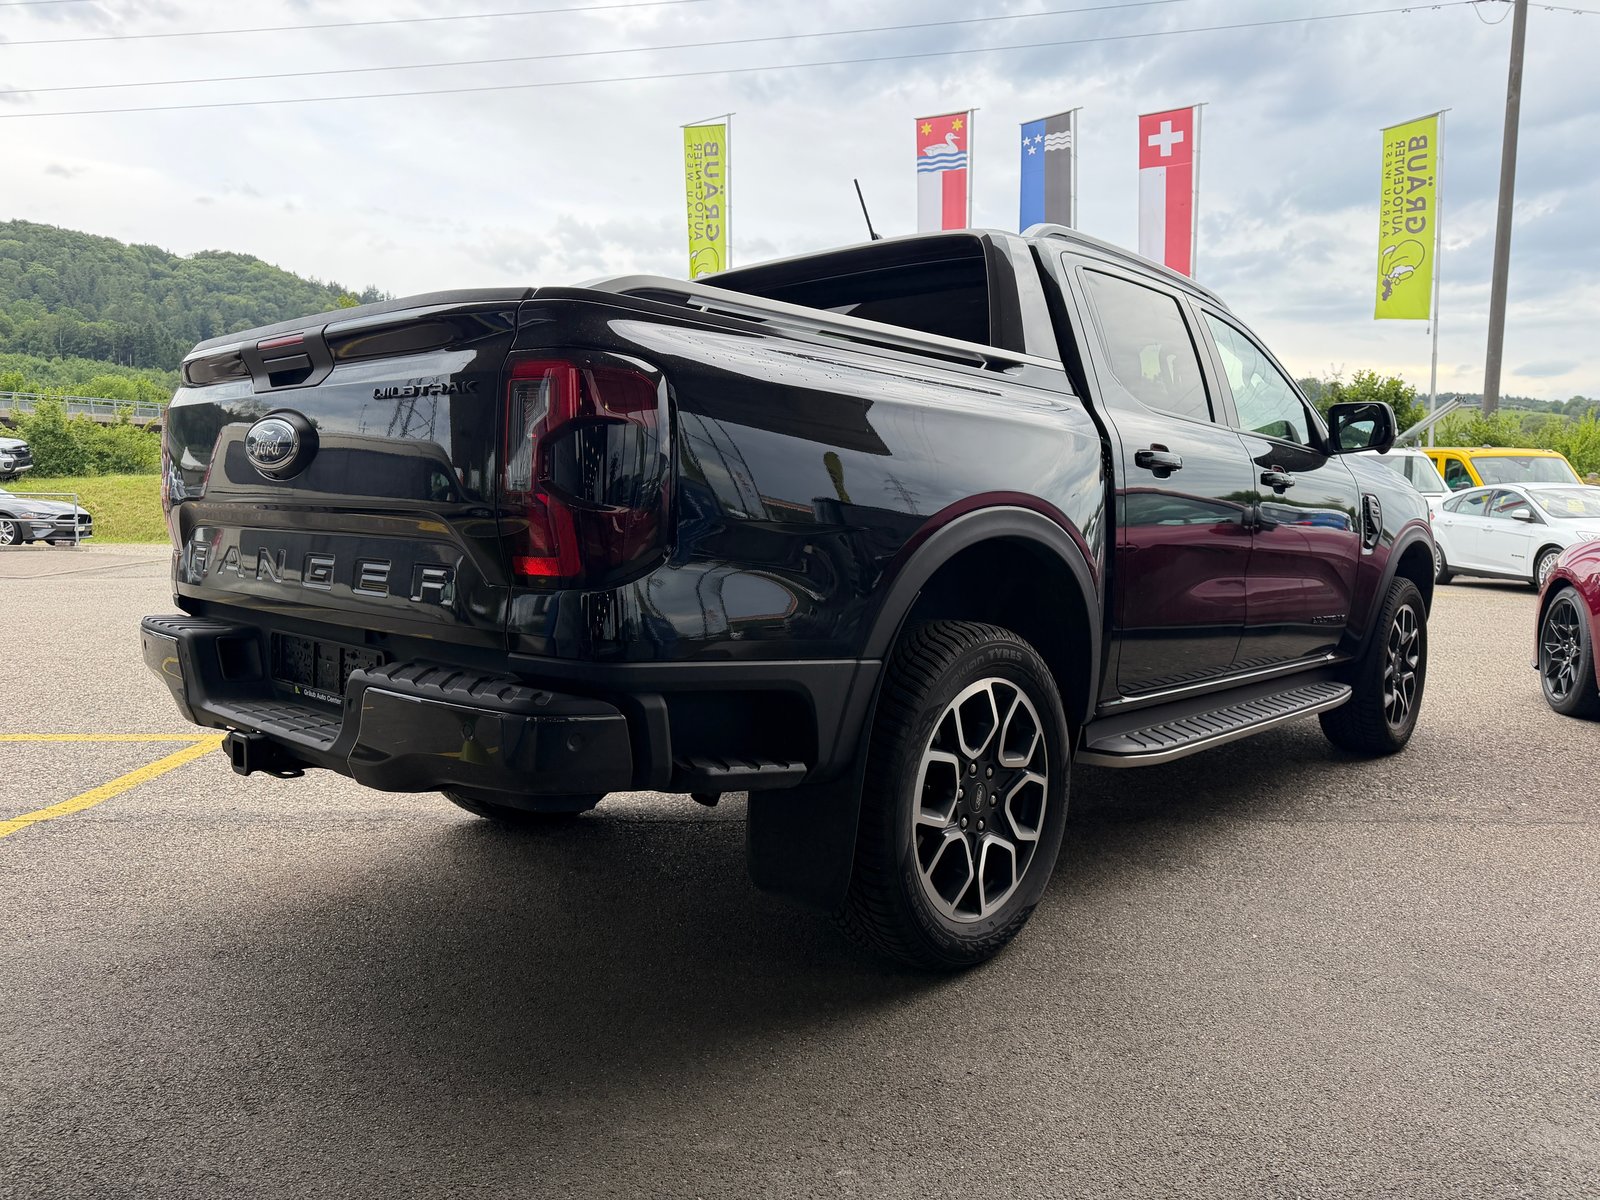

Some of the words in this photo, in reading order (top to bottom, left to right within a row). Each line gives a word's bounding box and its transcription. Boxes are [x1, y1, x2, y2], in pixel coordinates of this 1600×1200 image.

[253, 429, 281, 456] Ford
[188, 540, 457, 607] RANGER
[987, 647, 1023, 662] TYRES
[316, 692, 326, 701] Auto
